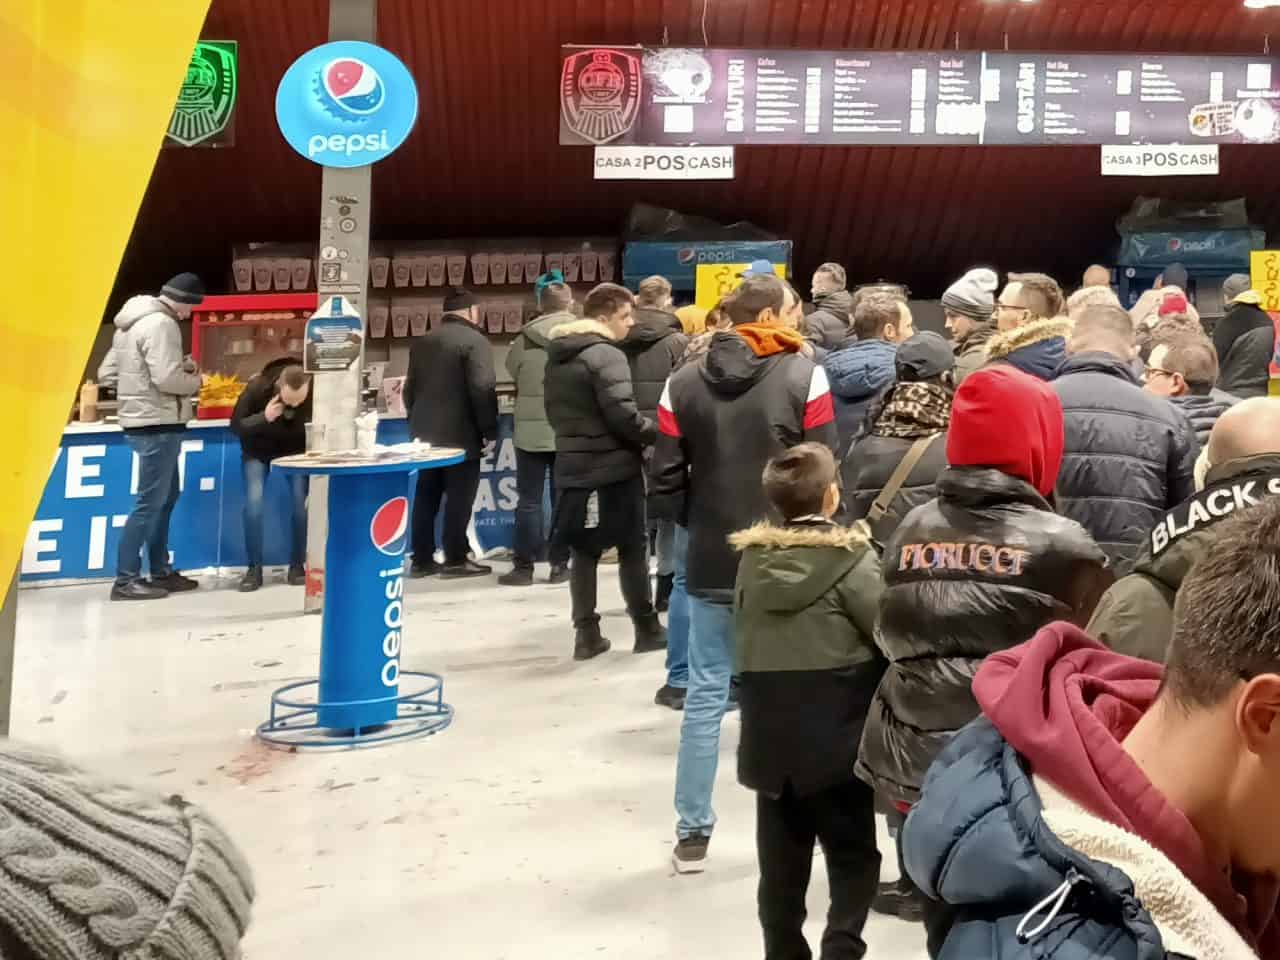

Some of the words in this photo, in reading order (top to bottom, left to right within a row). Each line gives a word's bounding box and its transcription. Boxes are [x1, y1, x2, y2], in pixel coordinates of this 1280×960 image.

[308, 128, 391, 157] pepsi
[595, 157, 632, 168] CASA
[635, 157, 642, 168] 2
[643, 154, 685, 171] POS
[687, 156, 733, 169] CASH
[1142, 152, 1178, 167] POS
[1179, 153, 1217, 166] CASH
[697, 248, 736, 263] pepsi
[1151, 481, 1261, 555] BLACK
